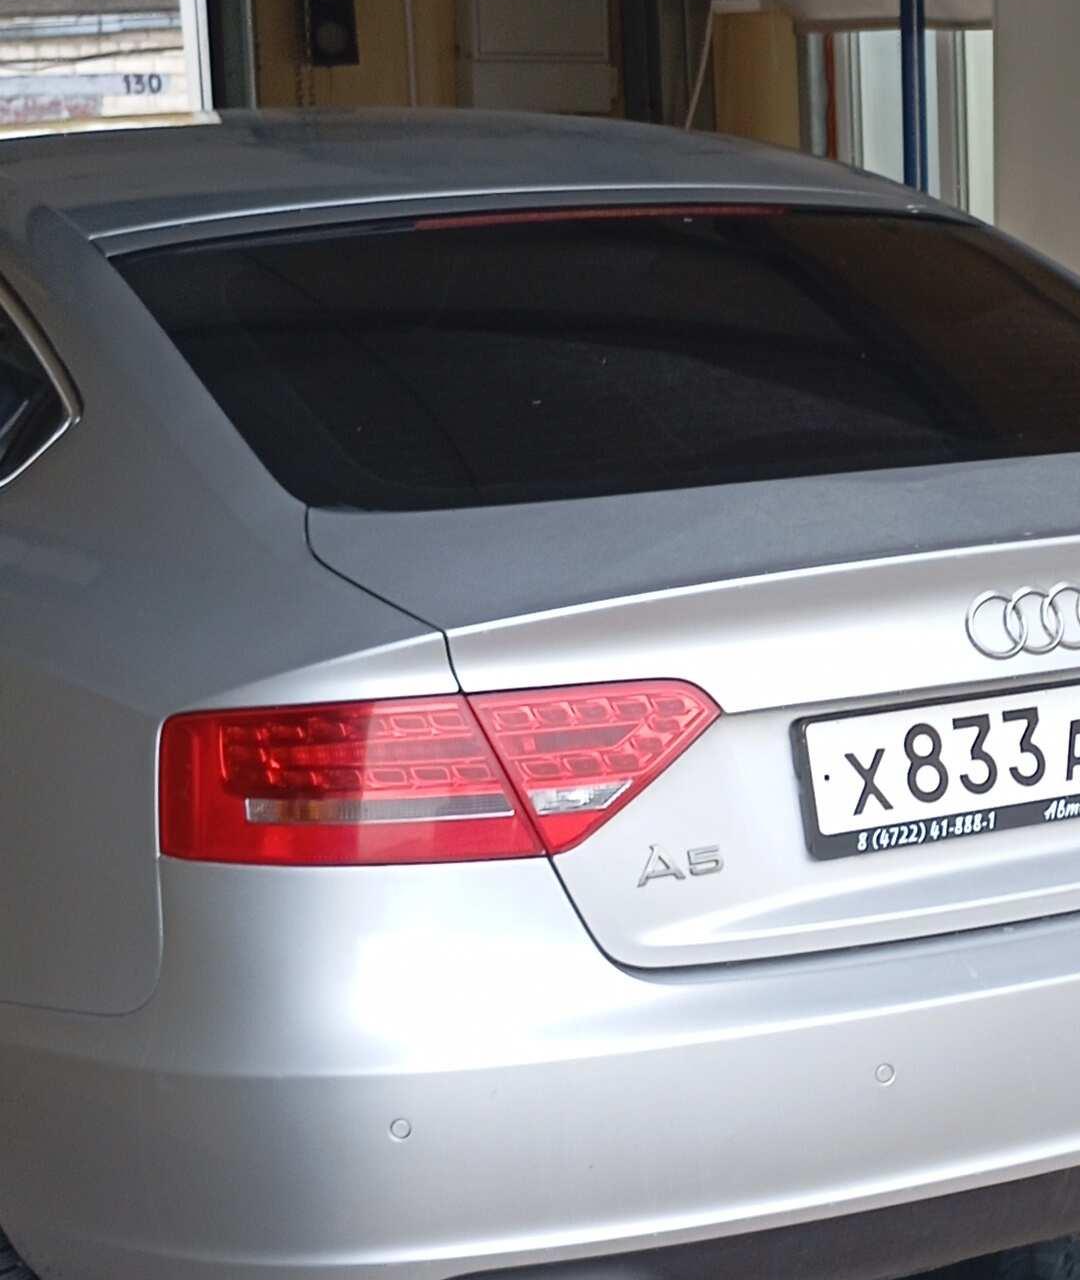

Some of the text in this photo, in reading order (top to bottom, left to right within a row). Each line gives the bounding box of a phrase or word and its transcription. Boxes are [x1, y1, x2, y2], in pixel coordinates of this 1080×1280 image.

[123, 73, 163, 94] 130
[857, 811, 996, 851] 8 (4722) 41-888-1
[636, 839, 725, 888] A5
